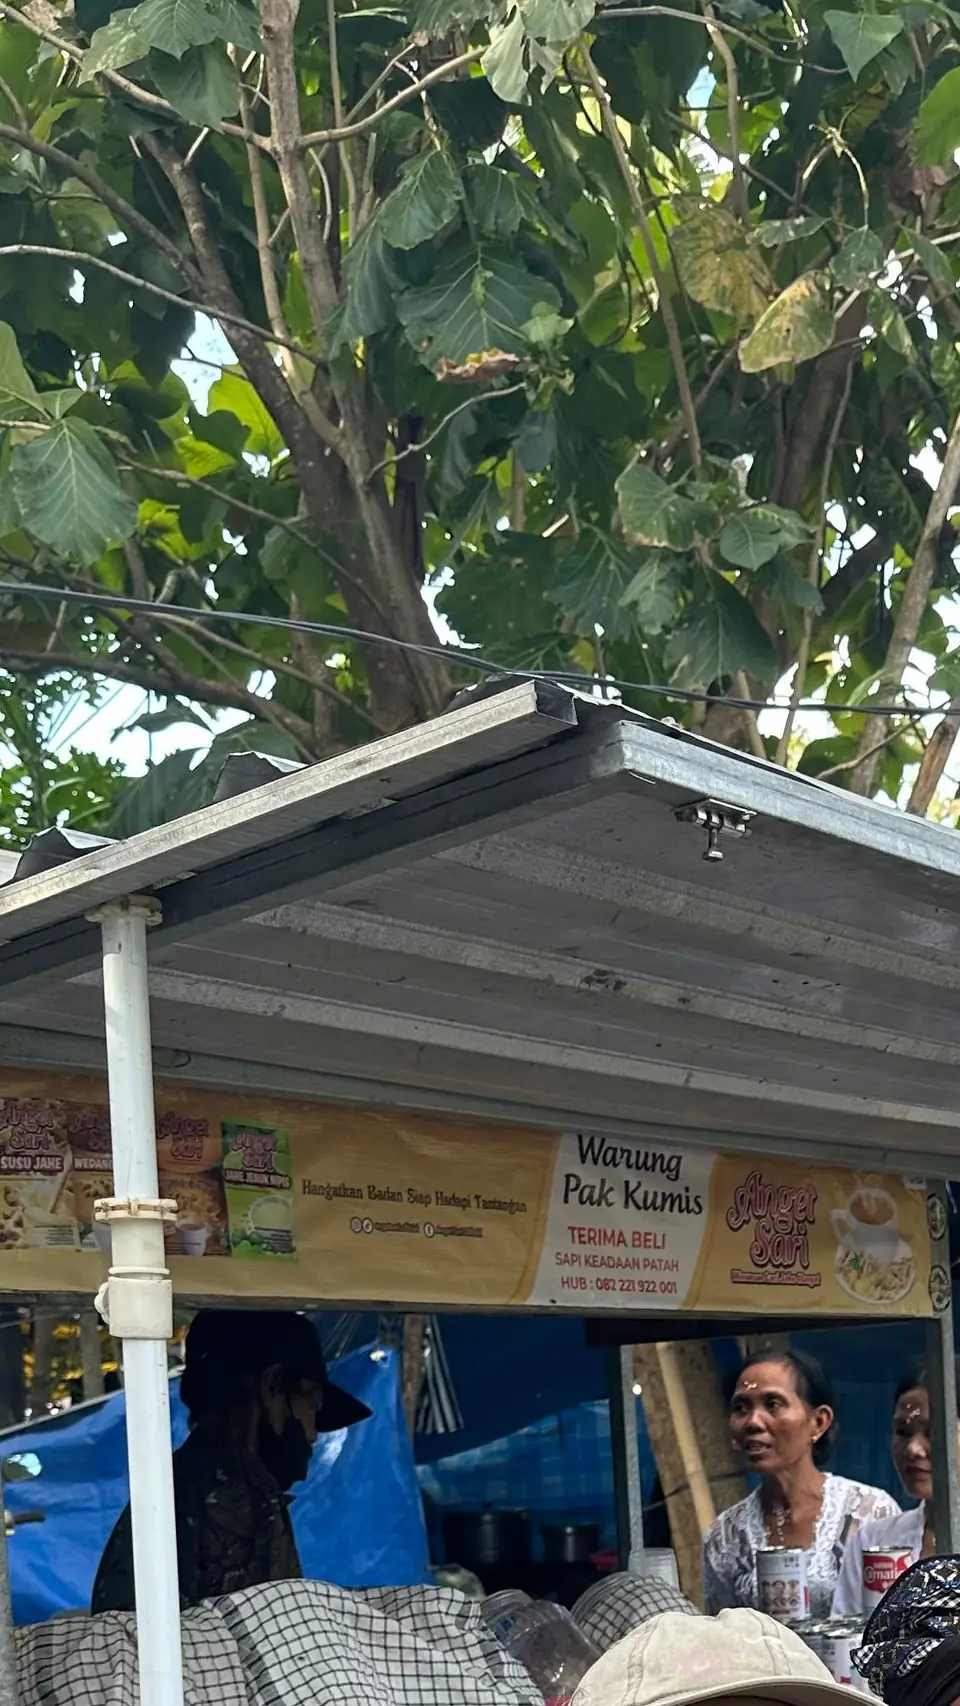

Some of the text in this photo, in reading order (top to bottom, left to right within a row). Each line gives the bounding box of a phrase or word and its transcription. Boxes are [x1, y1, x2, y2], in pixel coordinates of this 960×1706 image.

[1, 1156, 62, 1169] SUSU JAHE
[577, 1134, 683, 1182] Warung
[302, 1179, 526, 1215] Hangatkan Badan Siap Hadapi Tantangan
[563, 1173, 704, 1215] Pak Kumis
[726, 1171, 818, 1234] Anget
[567, 1225, 666, 1250] TERIMA BELI
[749, 1217, 809, 1269] Sari
[555, 1252, 679, 1272] SAPI KEADAAN PATAH
[561, 1275, 587, 1290] HUB
[595, 1277, 616, 1291] 082
[619, 1278, 636, 1292] 221
[638, 1280, 657, 1293] 922
[659, 1281, 678, 1294] 001
